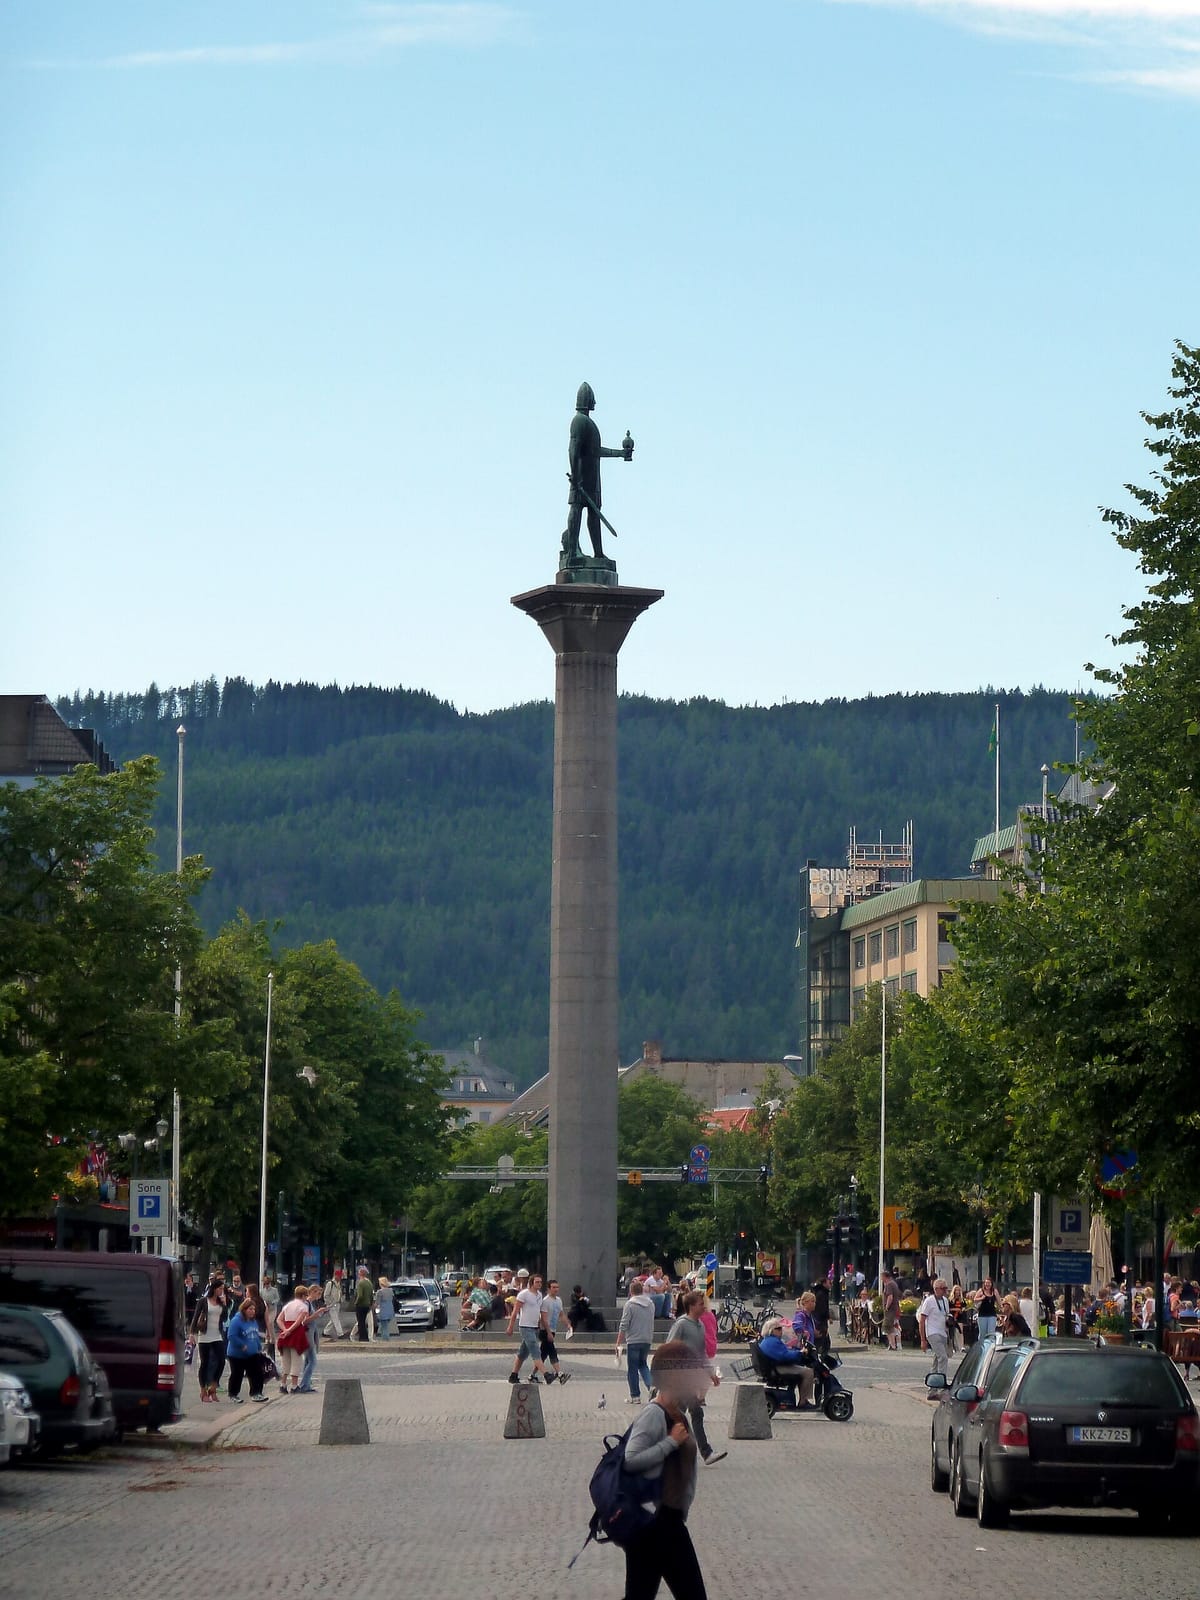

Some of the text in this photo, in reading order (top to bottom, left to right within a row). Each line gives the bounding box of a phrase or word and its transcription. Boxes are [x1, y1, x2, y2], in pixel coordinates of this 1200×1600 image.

[137, 1183, 162, 1193] Sone
[143, 1198, 155, 1216] P
[1065, 1213, 1076, 1230] P
[1081, 1428, 1129, 1441] KKZ-725
